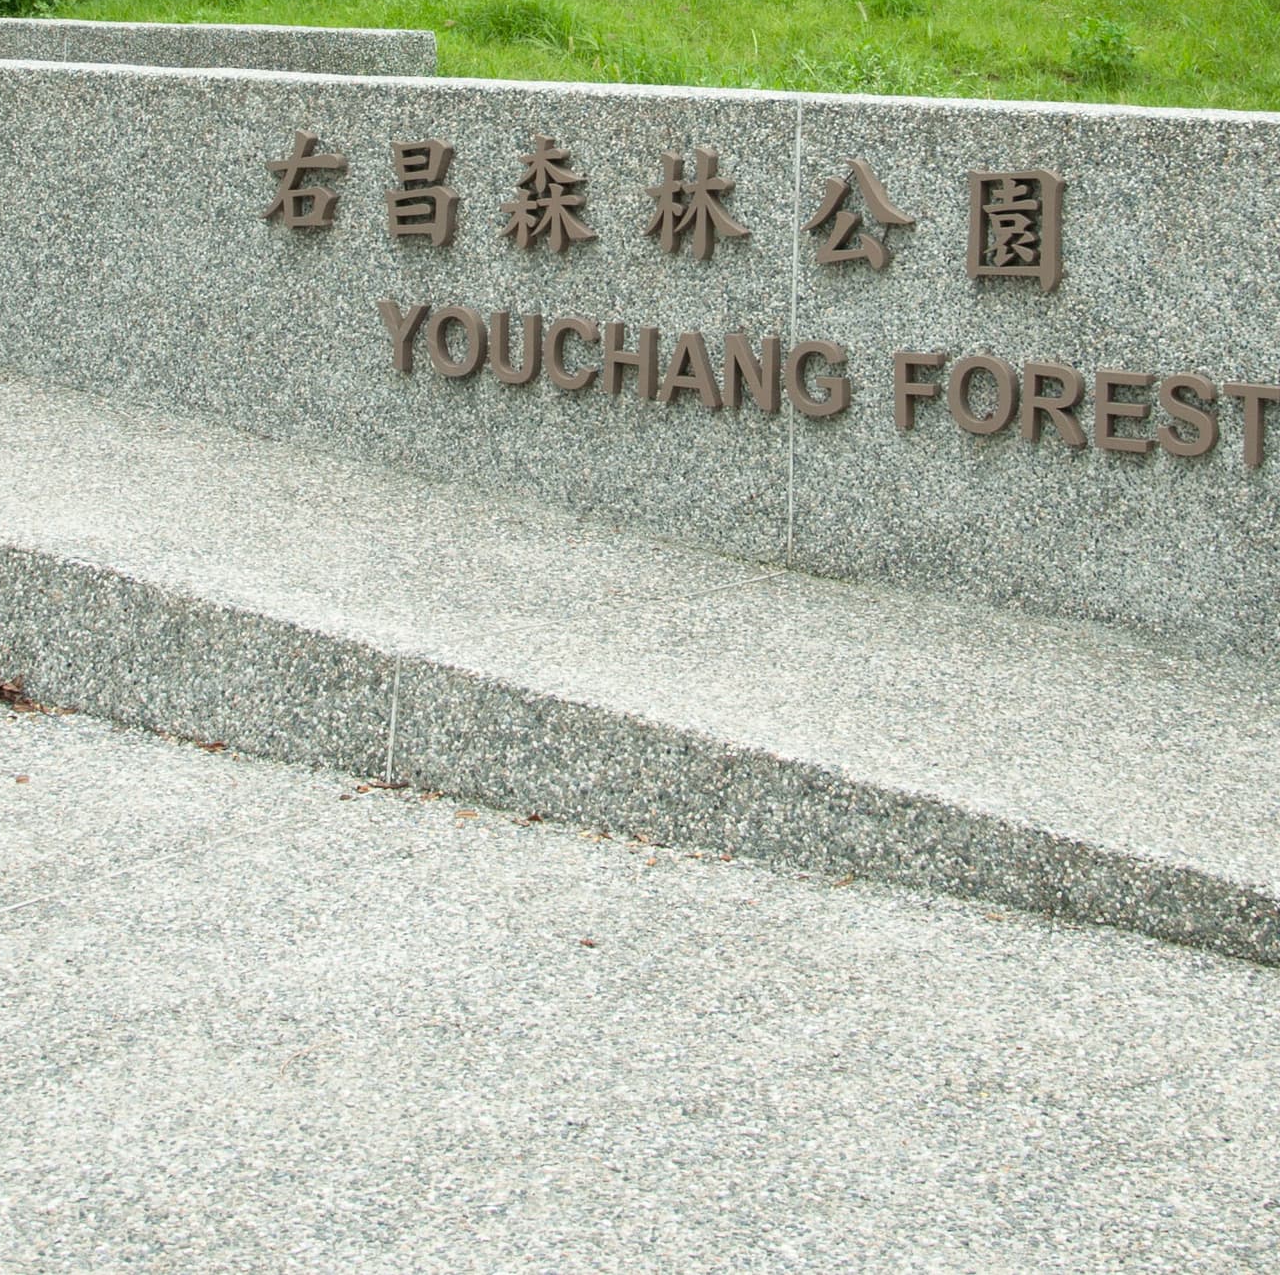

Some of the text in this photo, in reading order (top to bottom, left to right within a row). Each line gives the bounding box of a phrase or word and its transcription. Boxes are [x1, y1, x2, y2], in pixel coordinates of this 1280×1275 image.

[262, 129, 1066, 292] 右昌森林公園
[377, 299, 851, 417] YOUCHANG
